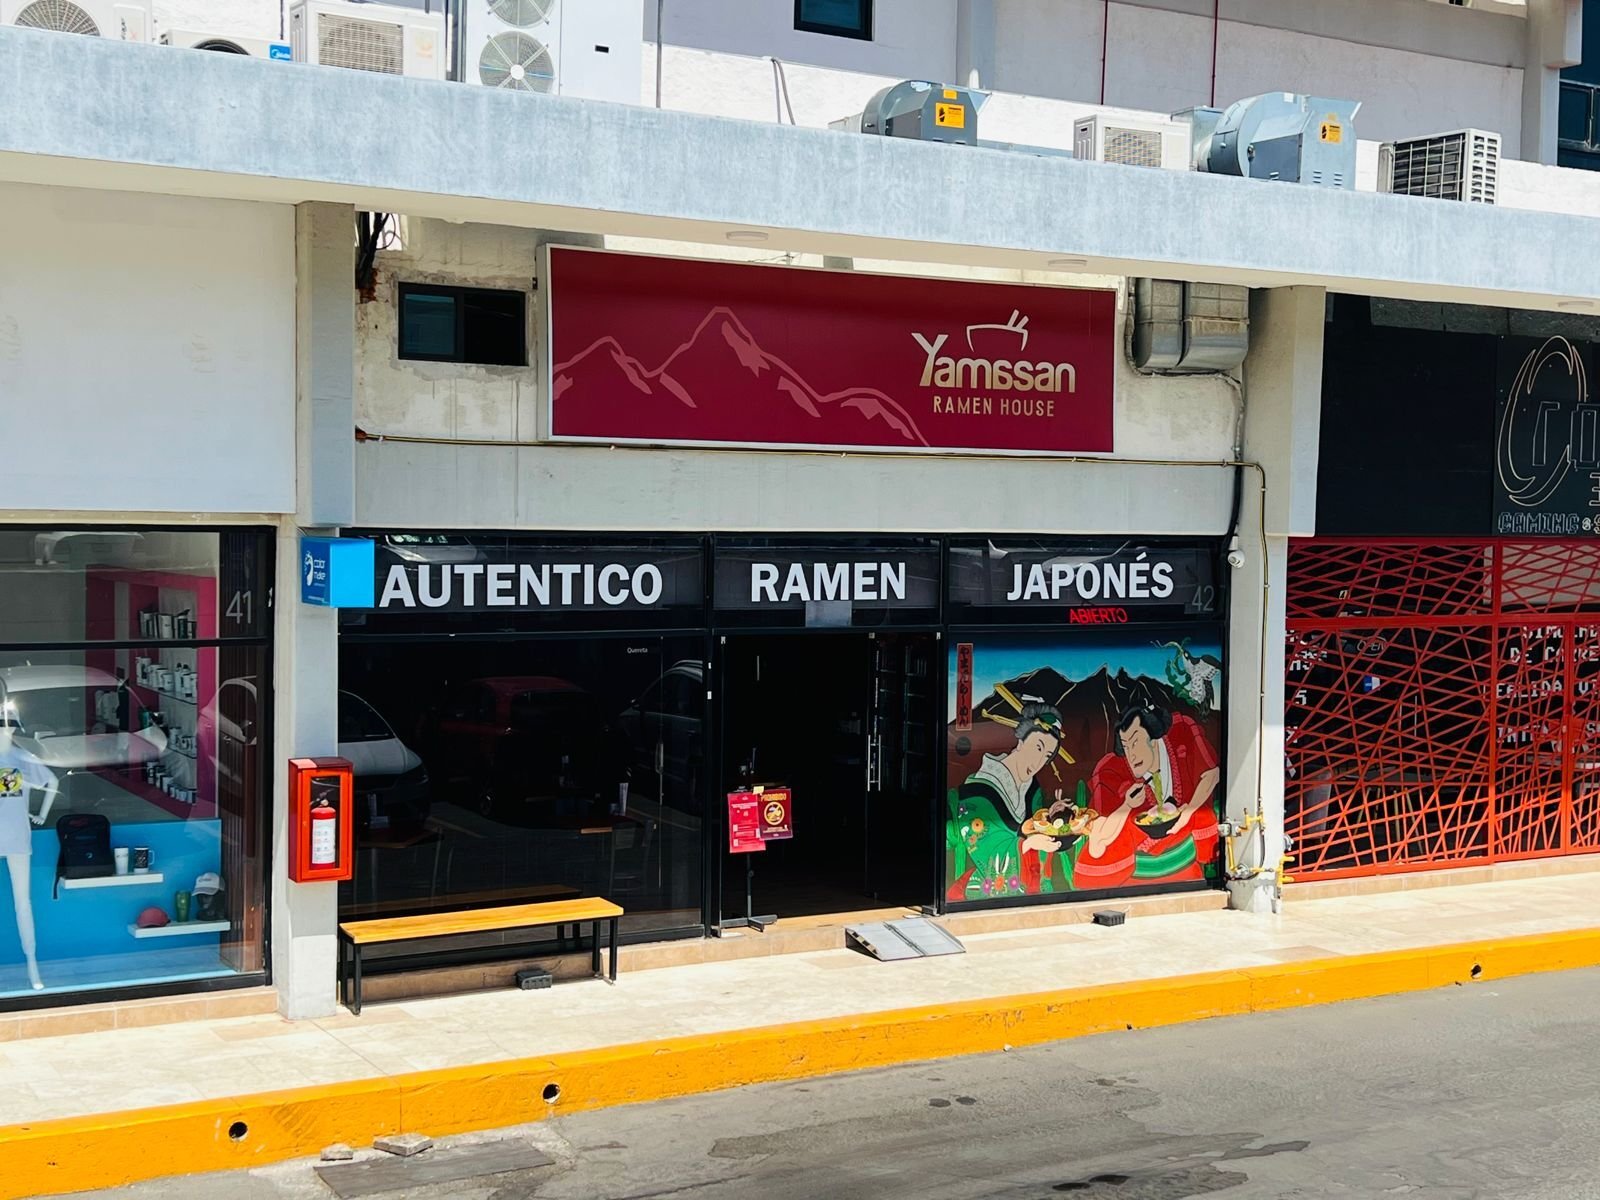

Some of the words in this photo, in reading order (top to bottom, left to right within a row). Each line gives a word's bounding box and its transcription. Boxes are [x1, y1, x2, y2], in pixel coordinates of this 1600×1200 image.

[933, 396, 993, 415] RAMEN
[1000, 398, 1055, 417] HOUSE
[378, 563, 663, 608] AUTENTICO
[751, 562, 906, 602] RAMEN
[1007, 551, 1175, 600] JAPONÉS
[225, 590, 253, 625] 41
[1069, 607, 1129, 625] ABIERTO
[1192, 584, 1215, 613] 42
